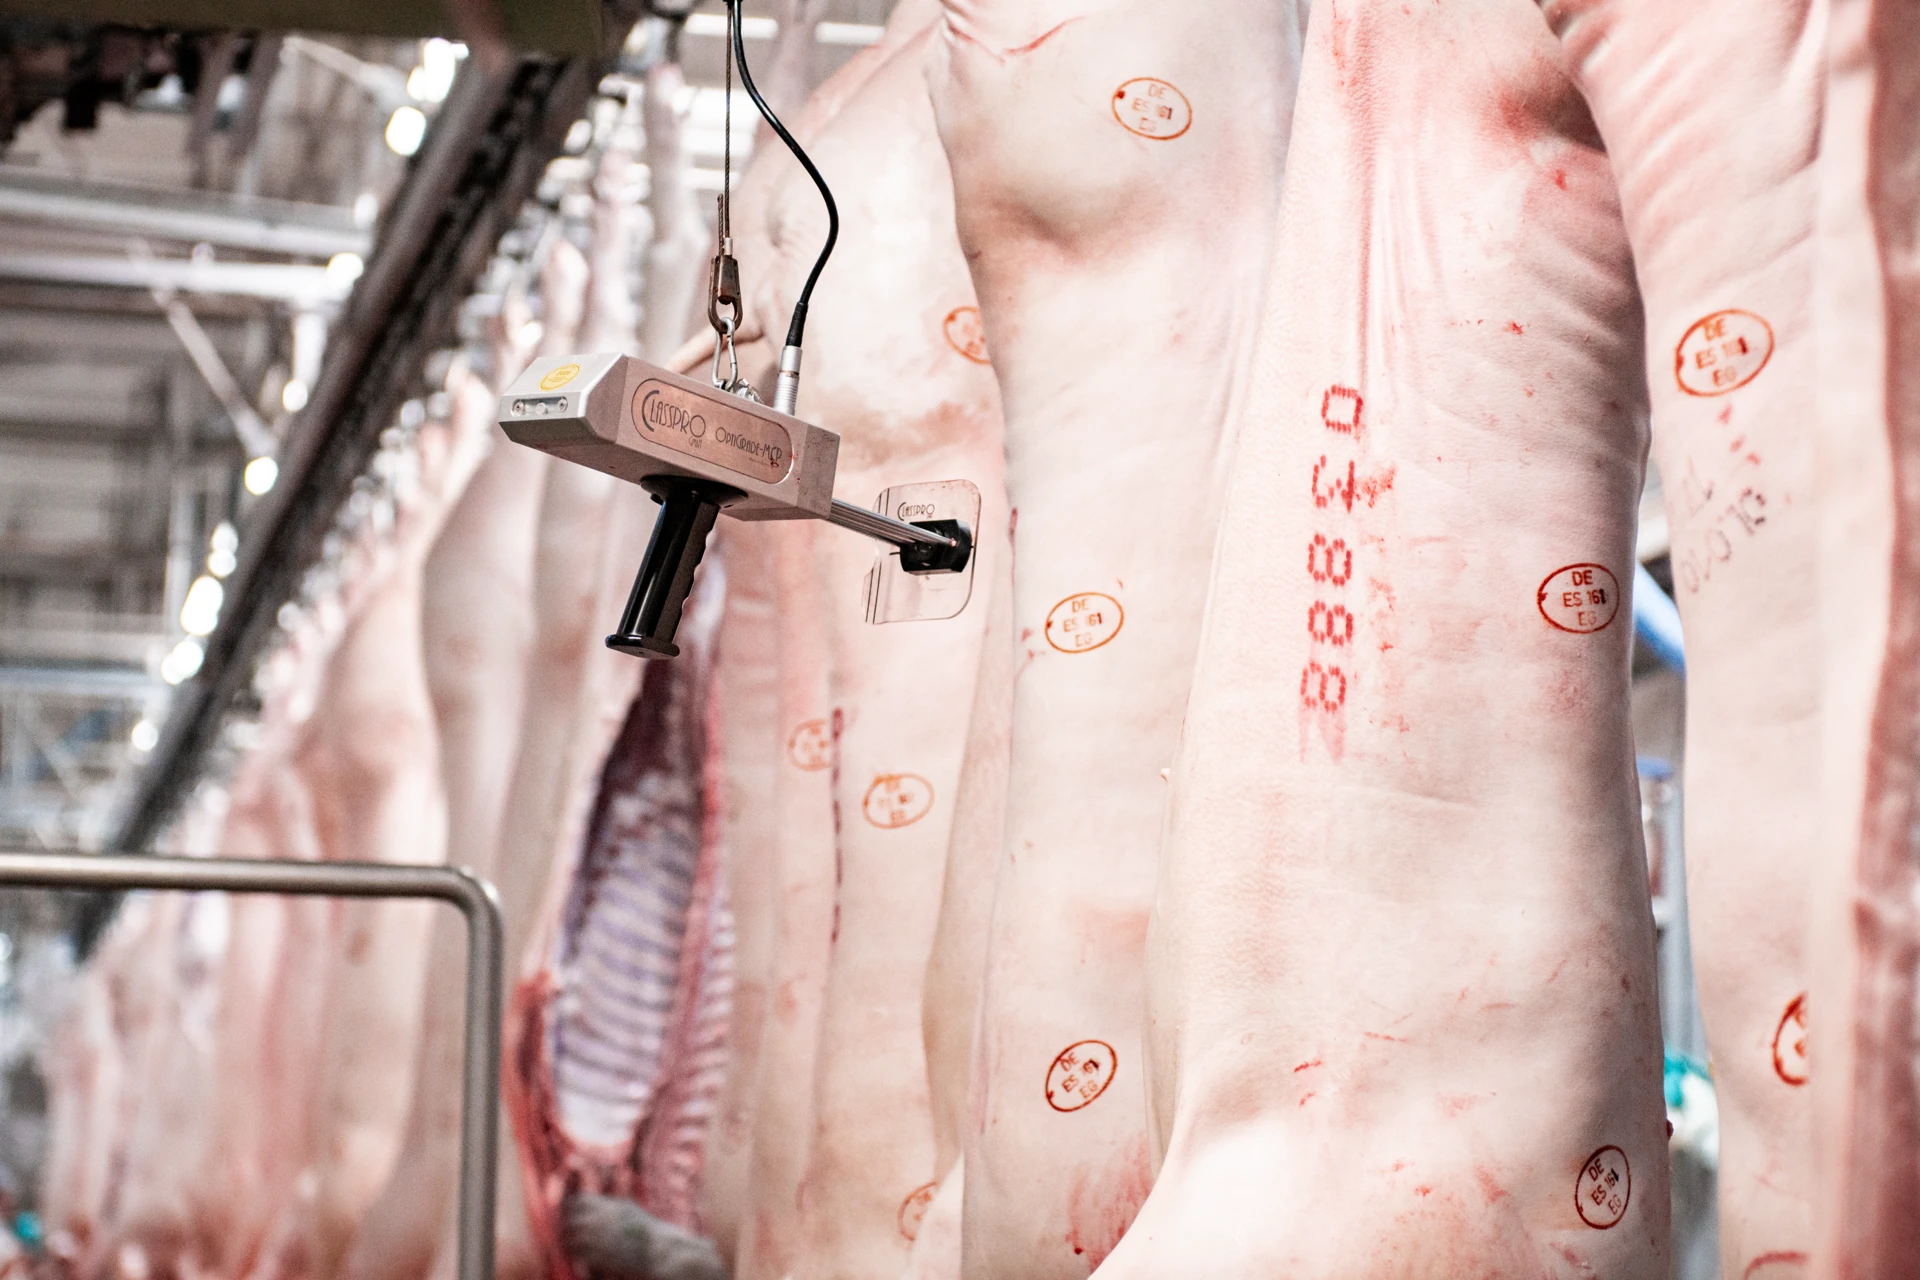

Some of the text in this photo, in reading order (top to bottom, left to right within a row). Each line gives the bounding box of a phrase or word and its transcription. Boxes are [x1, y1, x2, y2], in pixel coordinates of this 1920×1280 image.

[1571, 569, 1594, 587] DE
[1071, 598, 1090, 613] DE
[1562, 588, 1606, 608] ES 161
[1063, 612, 1102, 632] ES 61
[1060, 1052, 1079, 1072] DE
[1062, 1074, 1079, 1093] ES
[1588, 1158, 1605, 1182] DE
[1591, 1167, 1619, 1206] ES 161
[1608, 1194, 1622, 1215] EG
